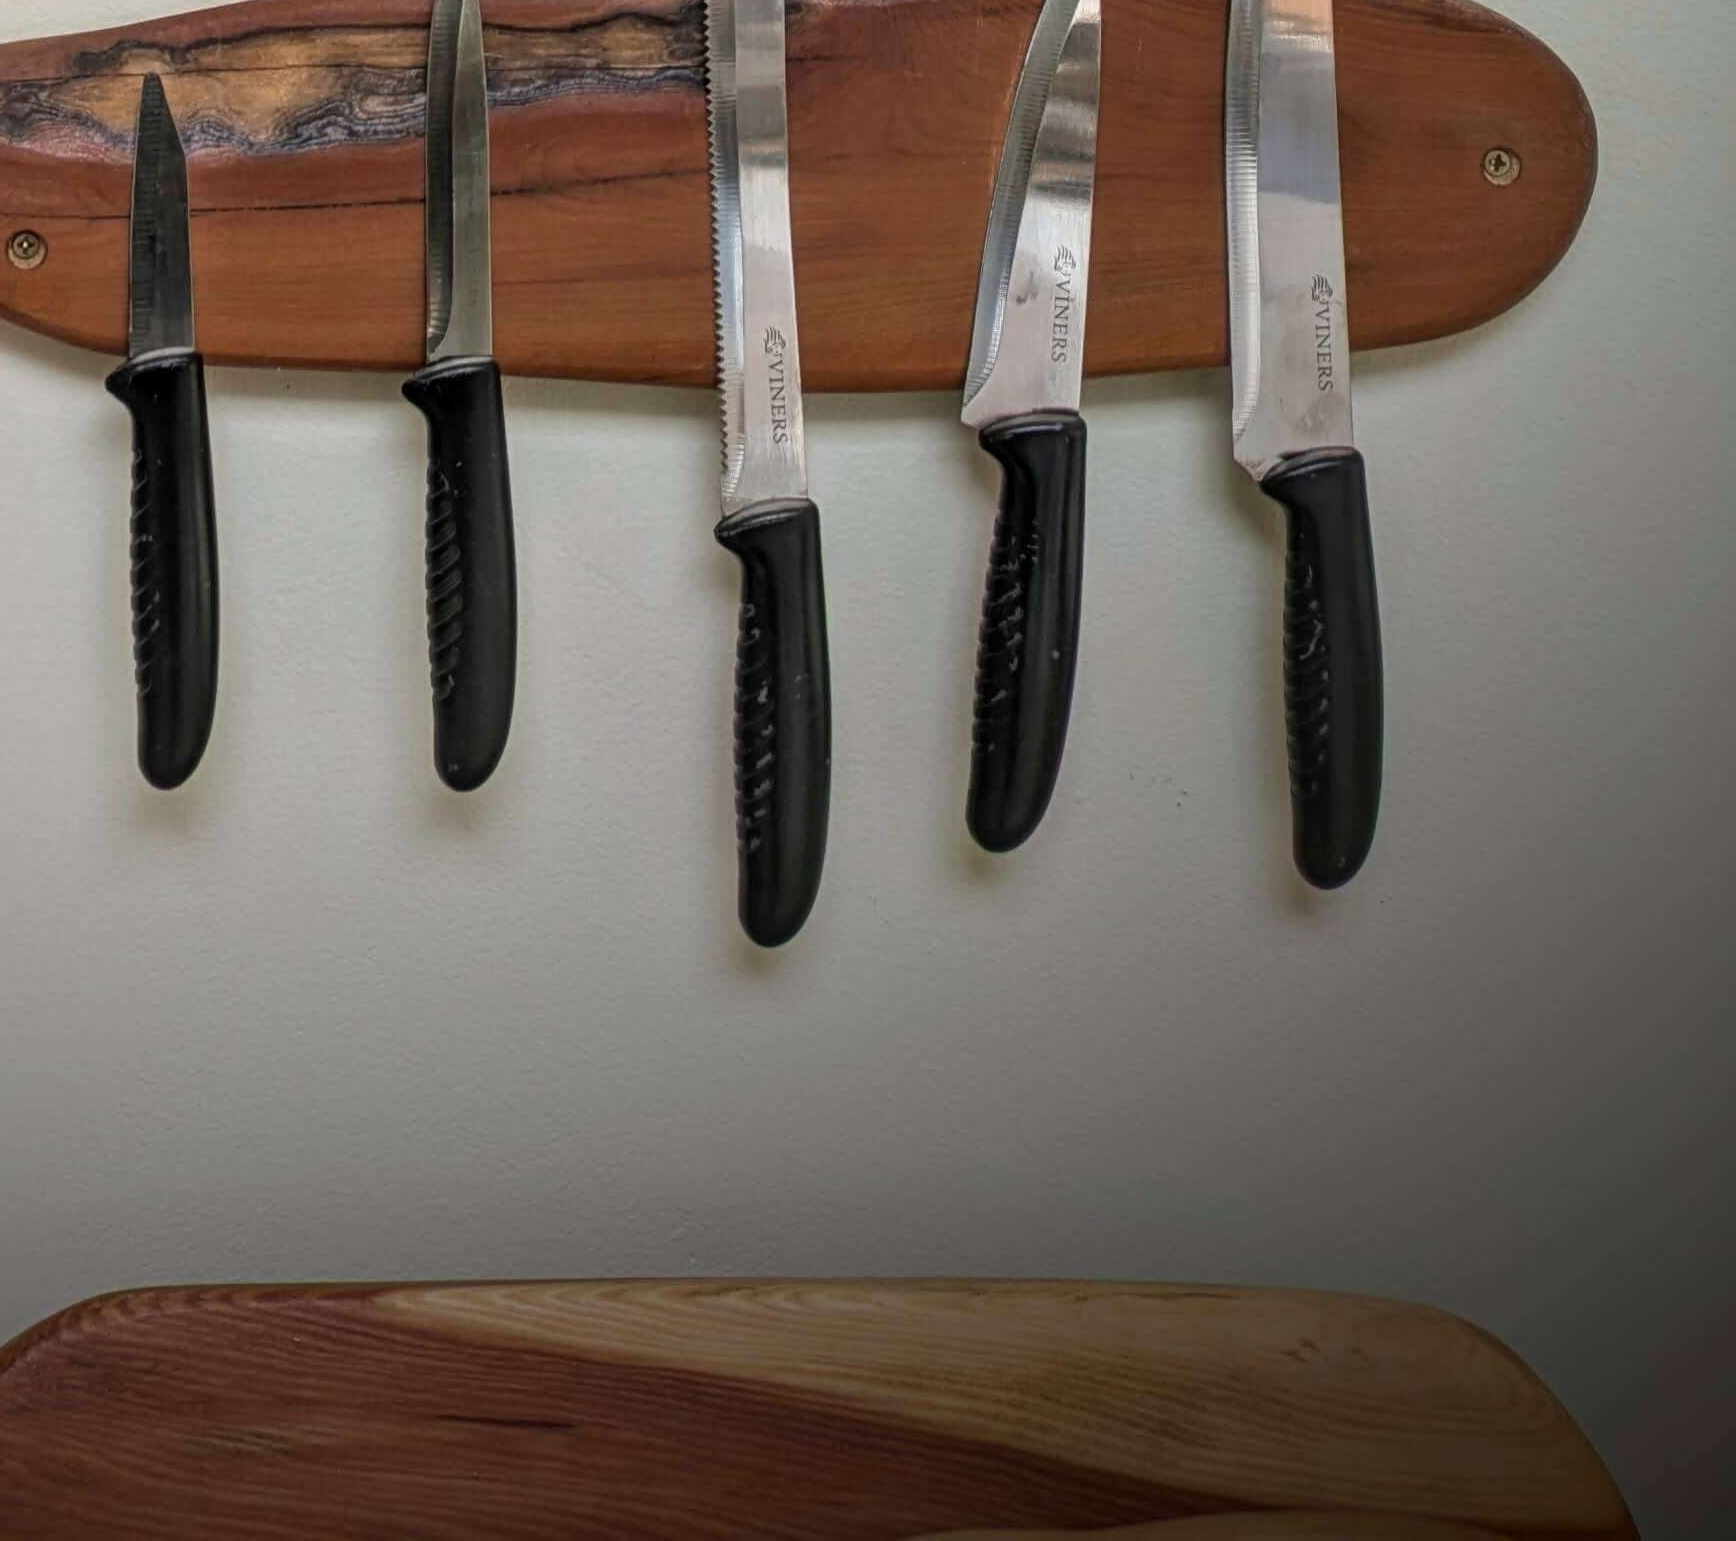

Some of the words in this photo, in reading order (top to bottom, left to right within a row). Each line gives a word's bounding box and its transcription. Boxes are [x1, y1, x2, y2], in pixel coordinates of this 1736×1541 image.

[1051, 278, 1072, 363] VINERS
[1315, 304, 1333, 391] VINERS
[768, 359, 788, 444] VINERS
